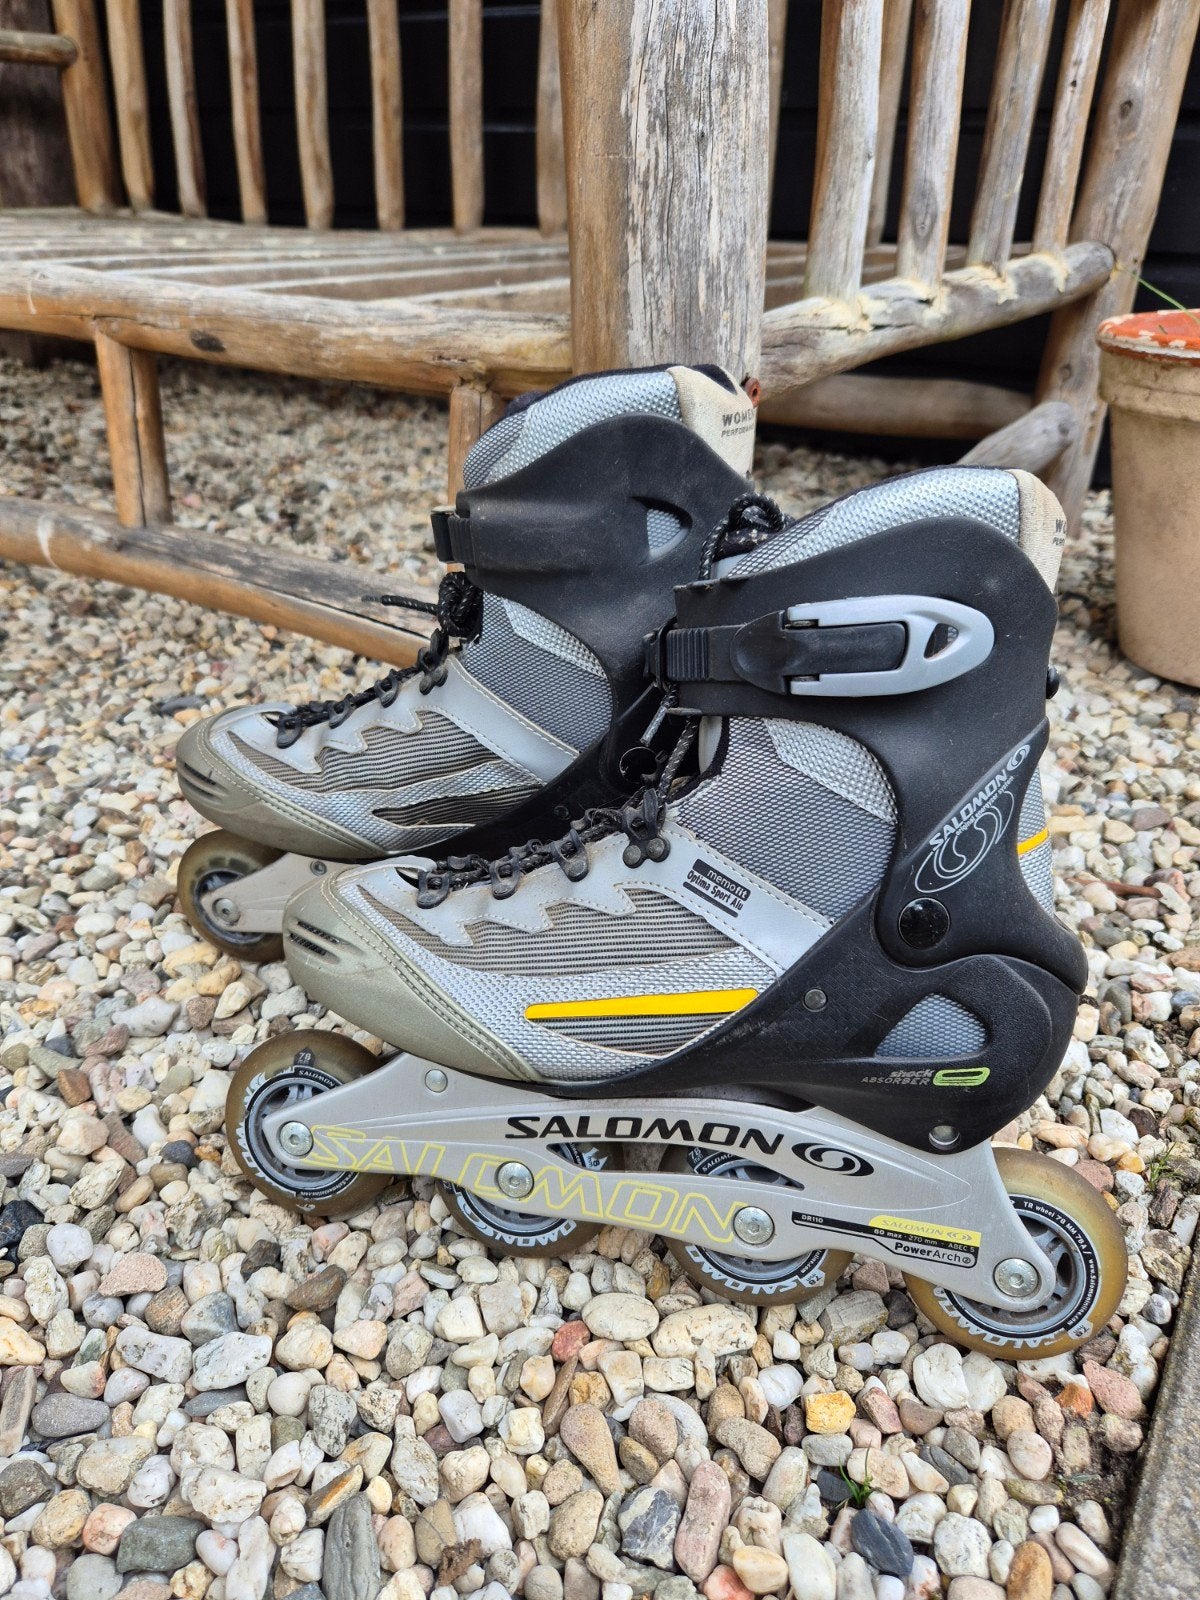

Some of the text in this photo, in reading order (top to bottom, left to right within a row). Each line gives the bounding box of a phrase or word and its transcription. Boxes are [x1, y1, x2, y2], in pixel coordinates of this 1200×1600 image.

[929, 768, 1008, 852] SALOMON
[956, 814, 976, 836] original
[998, 775, 1014, 795] system
[687, 869, 744, 911] Optima Sport Alu
[706, 870, 748, 899] memofit
[861, 1076, 930, 1086] ABSORBER
[890, 1068, 935, 1078] shock
[504, 1115, 785, 1156] SALOMON
[881, 1218, 944, 1237] SALOMON
[1023, 1201, 1034, 1209] TR
[1035, 1204, 1055, 1218] wheel
[1066, 1222, 1077, 1236] MM
[908, 1234, 923, 1243] 270
[924, 1238, 938, 1246] mm
[947, 1242, 968, 1252] ABEC
[685, 1244, 800, 1295] SALOMO
